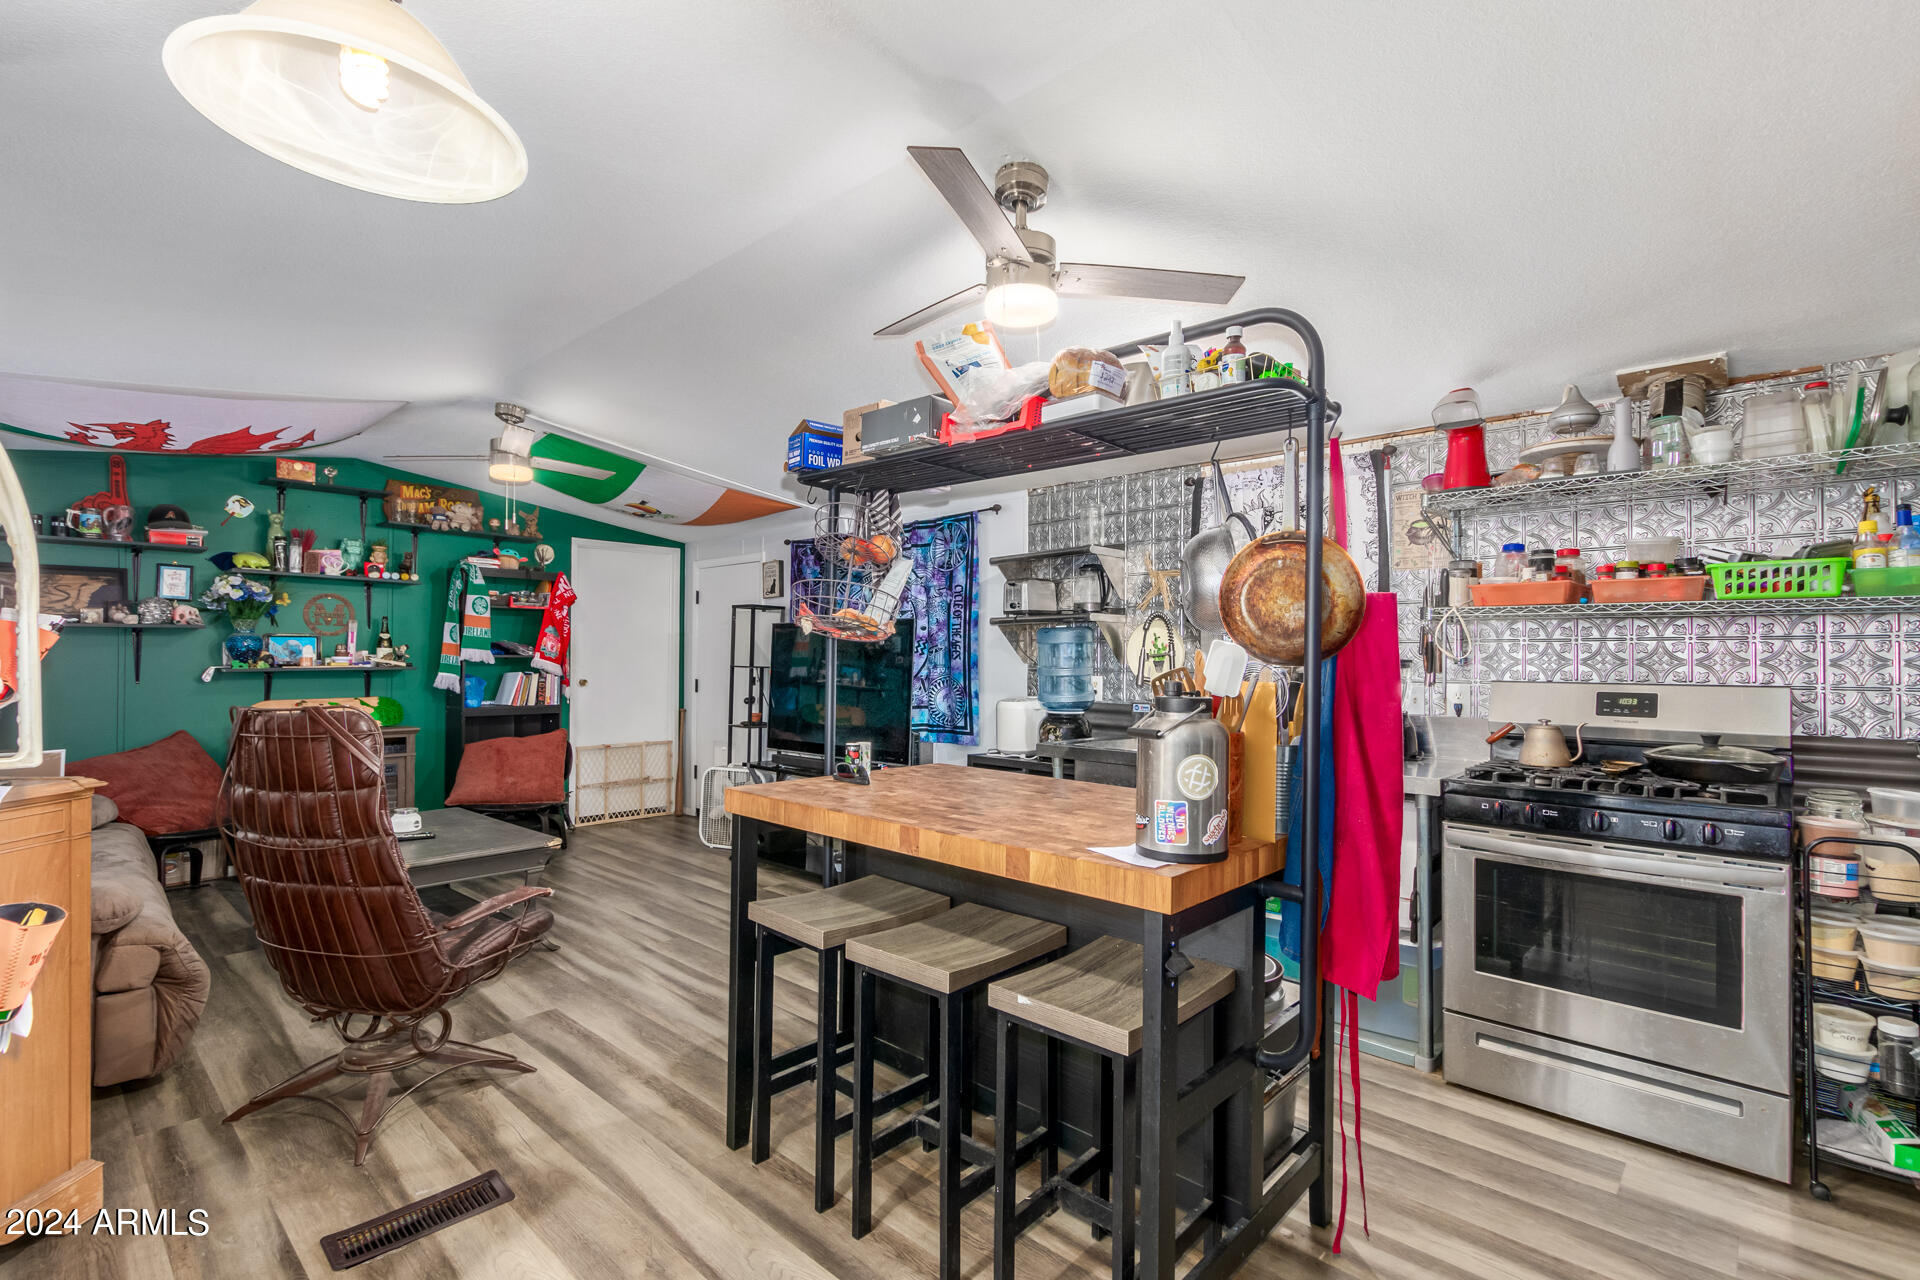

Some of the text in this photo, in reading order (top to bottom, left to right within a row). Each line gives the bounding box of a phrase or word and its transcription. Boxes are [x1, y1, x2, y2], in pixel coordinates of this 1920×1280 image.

[808, 454, 825, 467] FOIL
[1396, 492, 1416, 501] WITCH
[951, 584, 964, 660] CYCLE OF THE AGES
[1158, 804, 1166, 840] ALLOWED
[1166, 806, 1176, 841] WEENIES
[1176, 815, 1185, 829] NO
